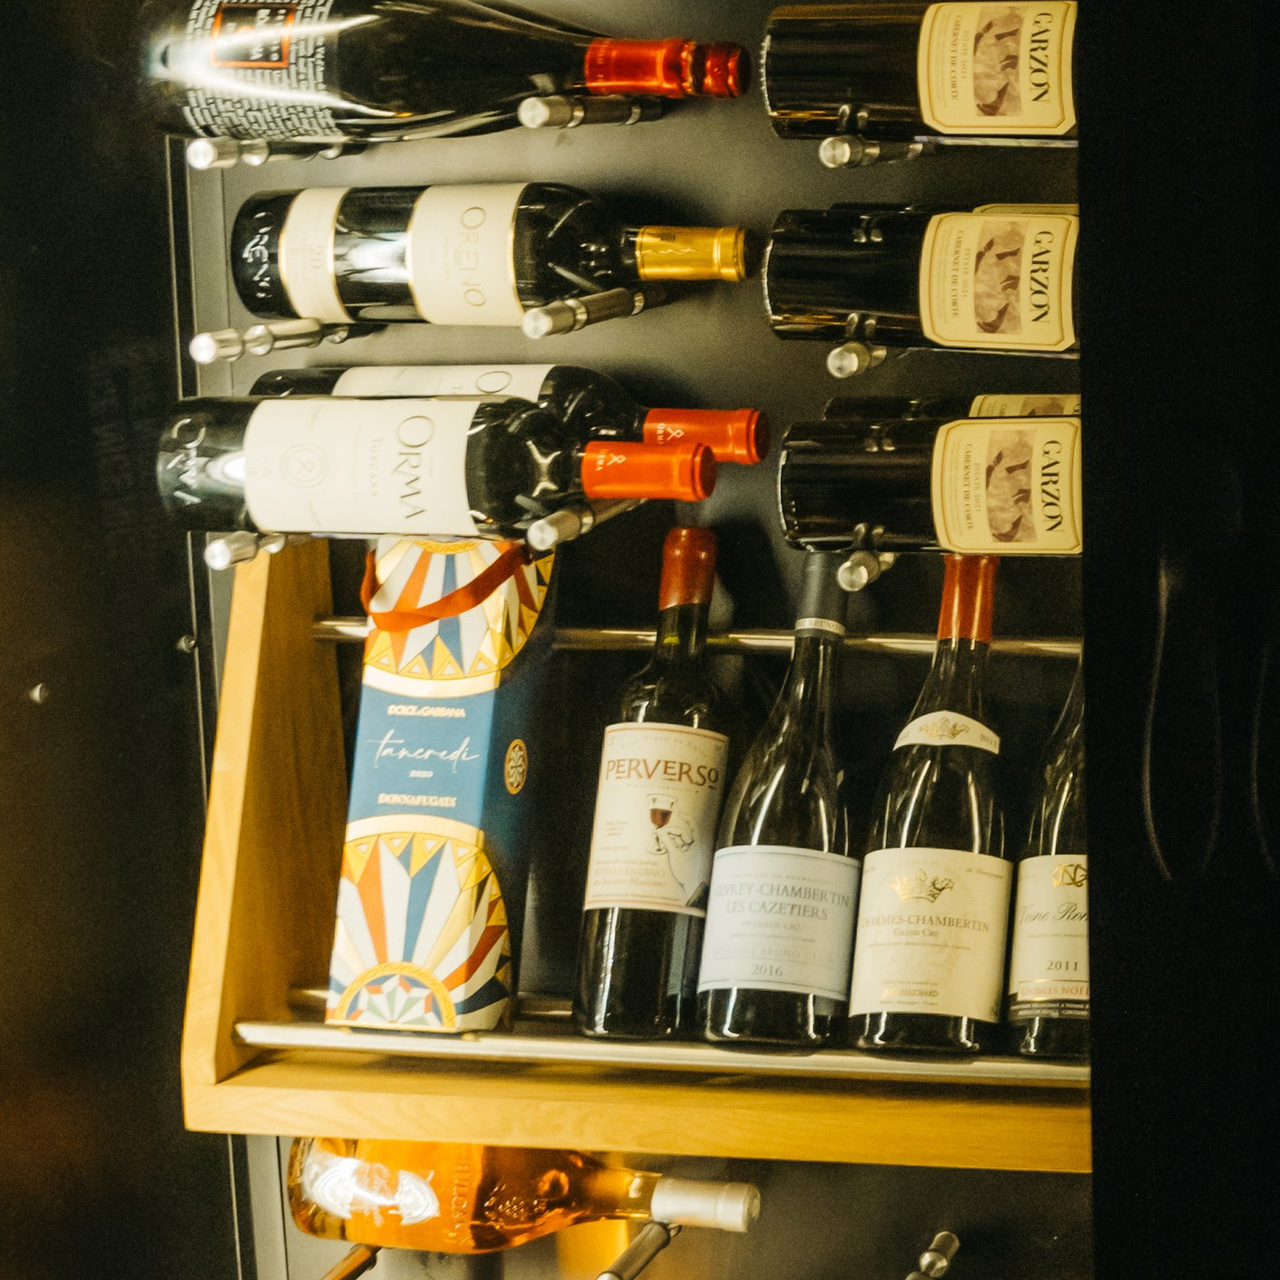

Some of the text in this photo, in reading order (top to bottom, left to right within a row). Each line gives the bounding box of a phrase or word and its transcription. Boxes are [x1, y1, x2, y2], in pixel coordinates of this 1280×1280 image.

[951, 14, 963, 55] CABERNET
[459, 206, 487, 307] ORENO
[953, 230, 964, 274] CABERNET
[392, 414, 436, 519] ORMA
[962, 443, 973, 489] CABERNET
[365, 728, 480, 774] tancredi
[604, 758, 720, 791] PERVERSO
[749, 900, 829, 921] CAZETIERS
[751, 964, 784, 977] 2016
[1046, 960, 1080, 971] 2011
